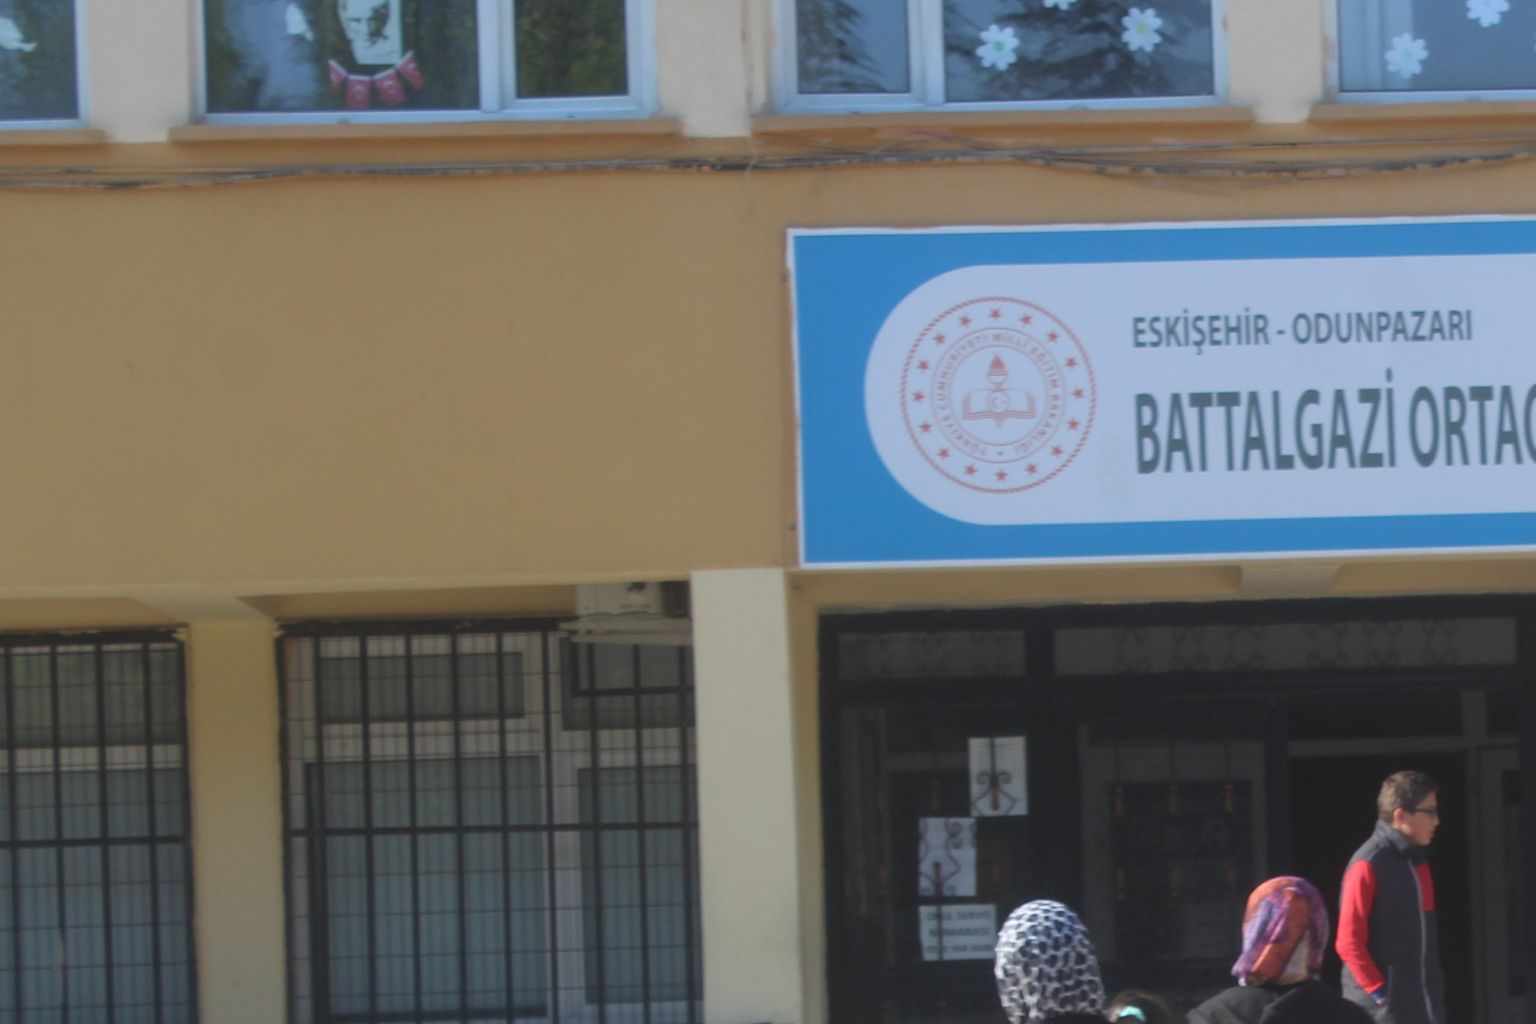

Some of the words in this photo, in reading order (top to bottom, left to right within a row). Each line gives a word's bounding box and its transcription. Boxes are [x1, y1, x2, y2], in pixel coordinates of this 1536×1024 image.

[1132, 308, 1270, 356] ESKİŞEHİR
[1292, 310, 1473, 344] ODUNPAZARI
[1135, 367, 1397, 475] BATTALGAZİ
